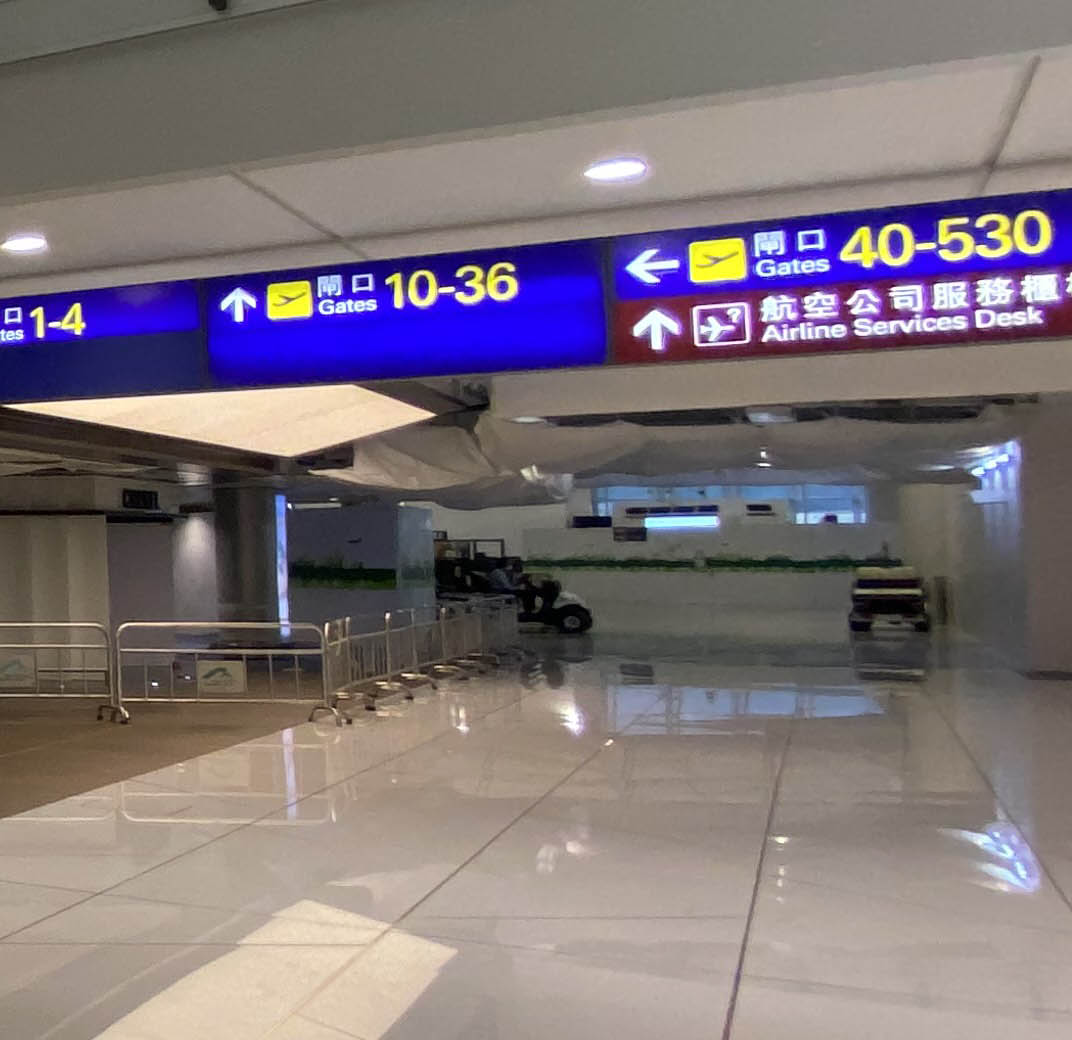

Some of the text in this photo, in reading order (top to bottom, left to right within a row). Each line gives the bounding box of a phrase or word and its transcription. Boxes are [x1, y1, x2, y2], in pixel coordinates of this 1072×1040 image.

[755, 209, 1053, 278] Gates 40-530
[318, 262, 519, 315] Gates 10-36
[760, 271, 1072, 323] 航空公司服務櫃
[29, 303, 86, 338] 1-4
[760, 306, 1044, 342] Airline Services Desk
